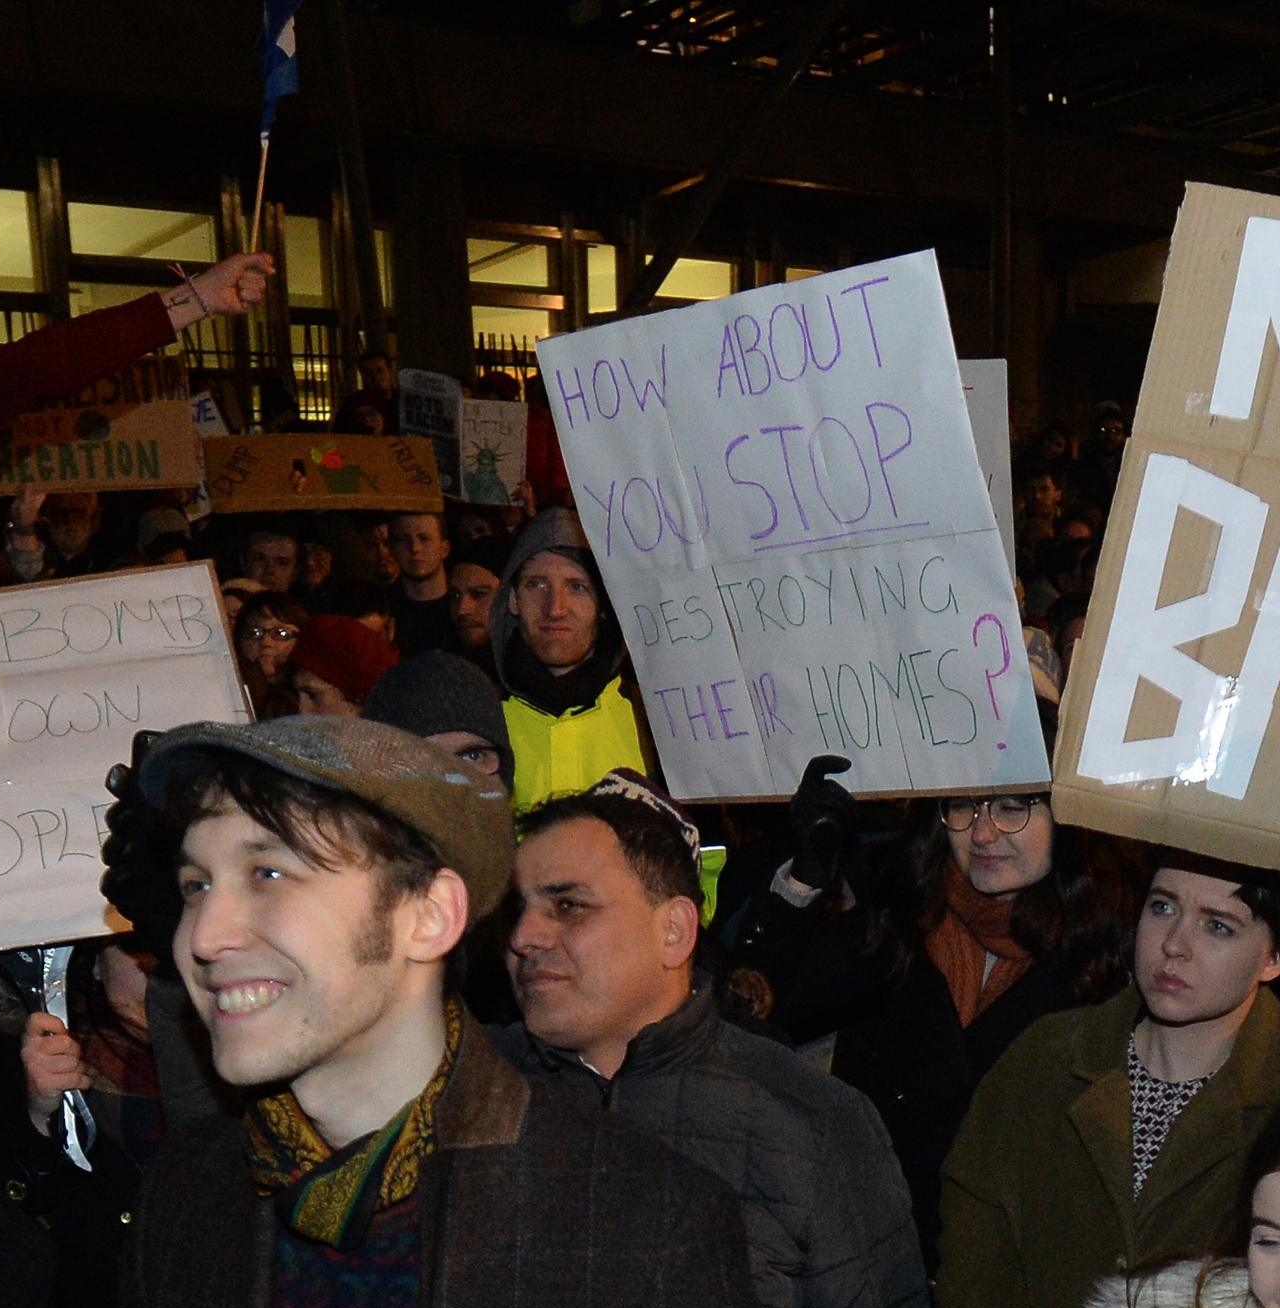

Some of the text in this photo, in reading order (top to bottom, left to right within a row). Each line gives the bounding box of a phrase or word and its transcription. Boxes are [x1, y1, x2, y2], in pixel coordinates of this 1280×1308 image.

[556, 276, 889, 429] HOW ABOUT
[583, 402, 913, 556] YOU STOP
[633, 555, 960, 648] DESTROYING
[654, 612, 1013, 752] THEIR HOMES?
